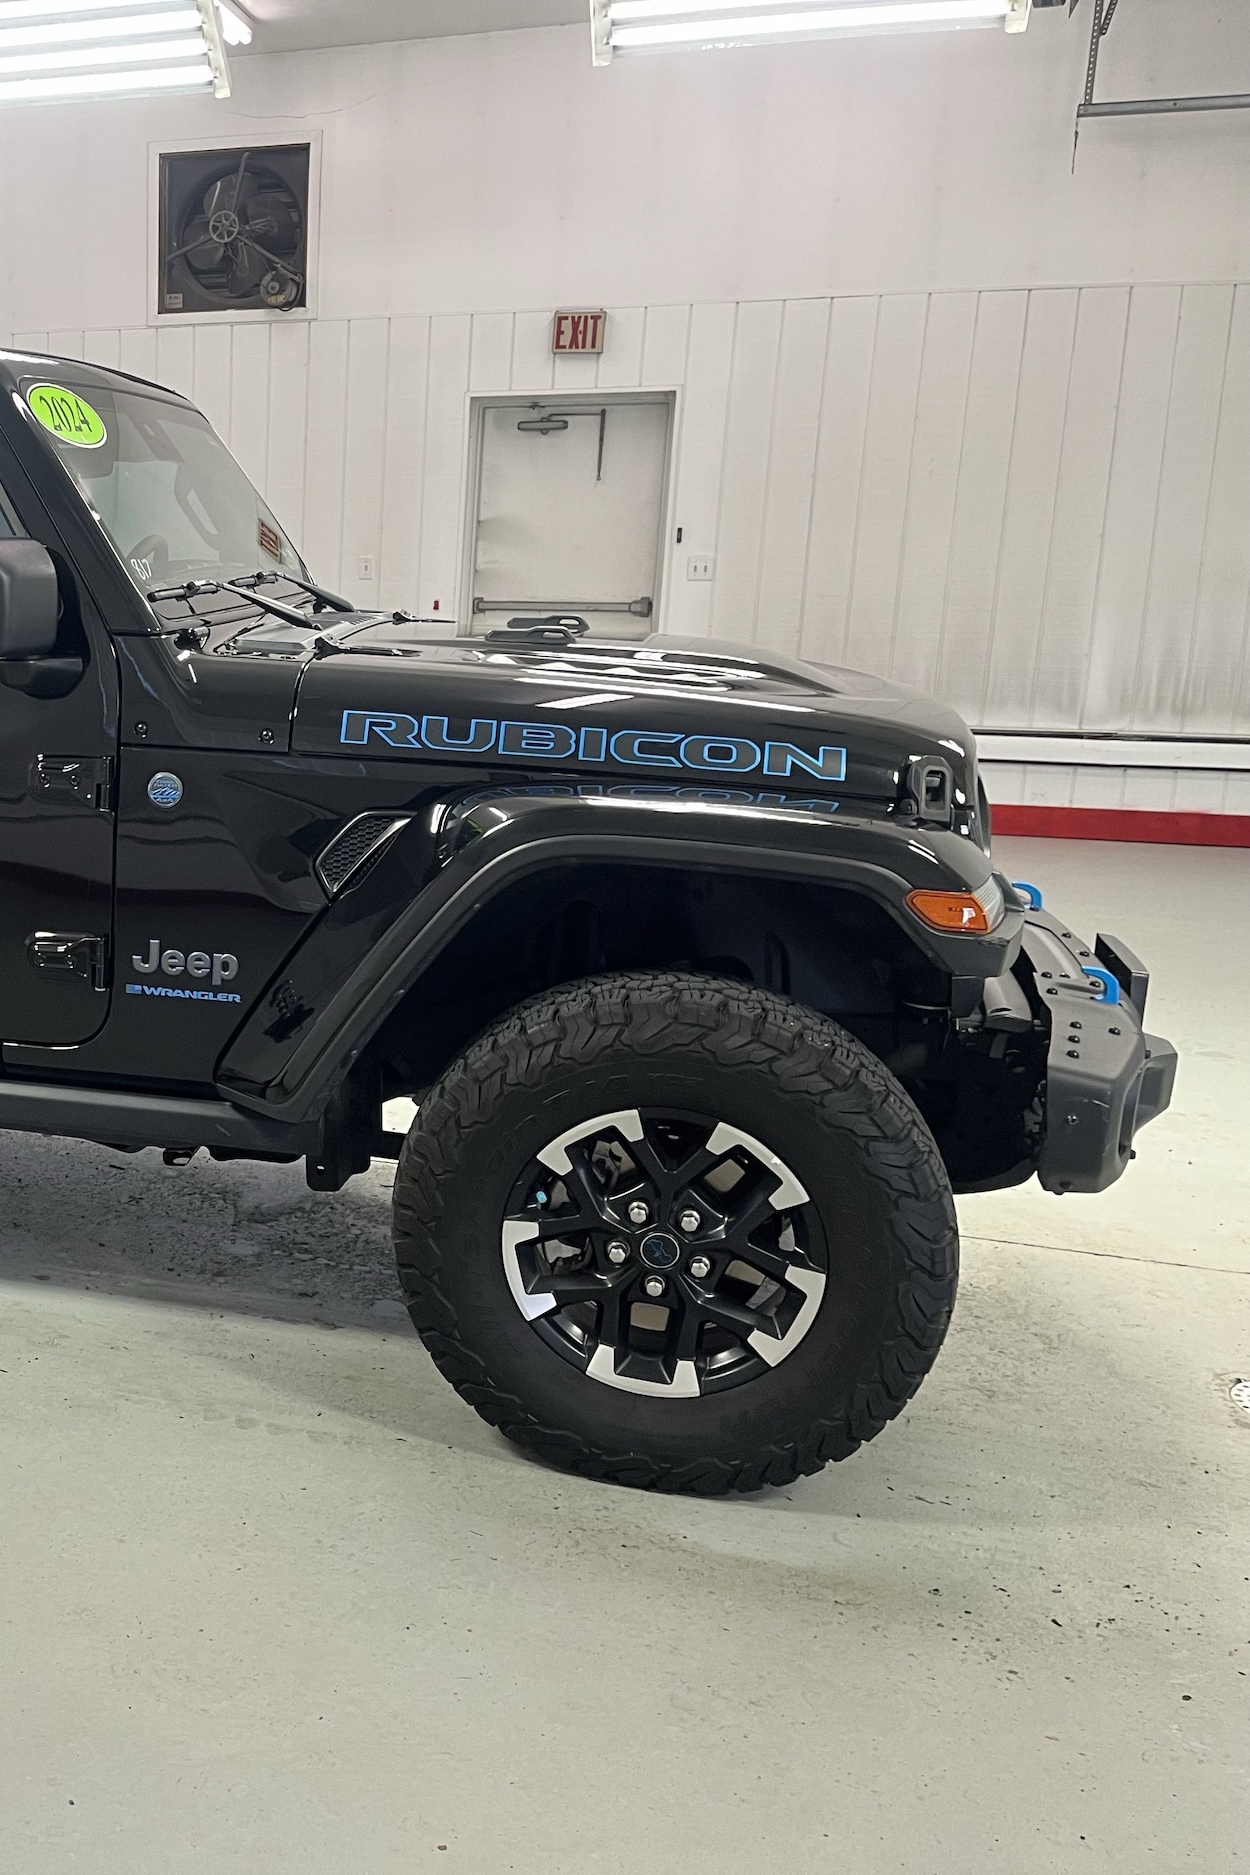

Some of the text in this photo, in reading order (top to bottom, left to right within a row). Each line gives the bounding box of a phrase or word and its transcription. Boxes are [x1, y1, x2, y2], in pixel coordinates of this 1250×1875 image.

[554, 315, 602, 349] EXIT
[39, 395, 93, 432] 2024
[130, 558, 152, 580] 817
[339, 709, 847, 782] RUBICON
[132, 939, 239, 985] Jeep
[143, 985, 242, 1003] WRANGLER
